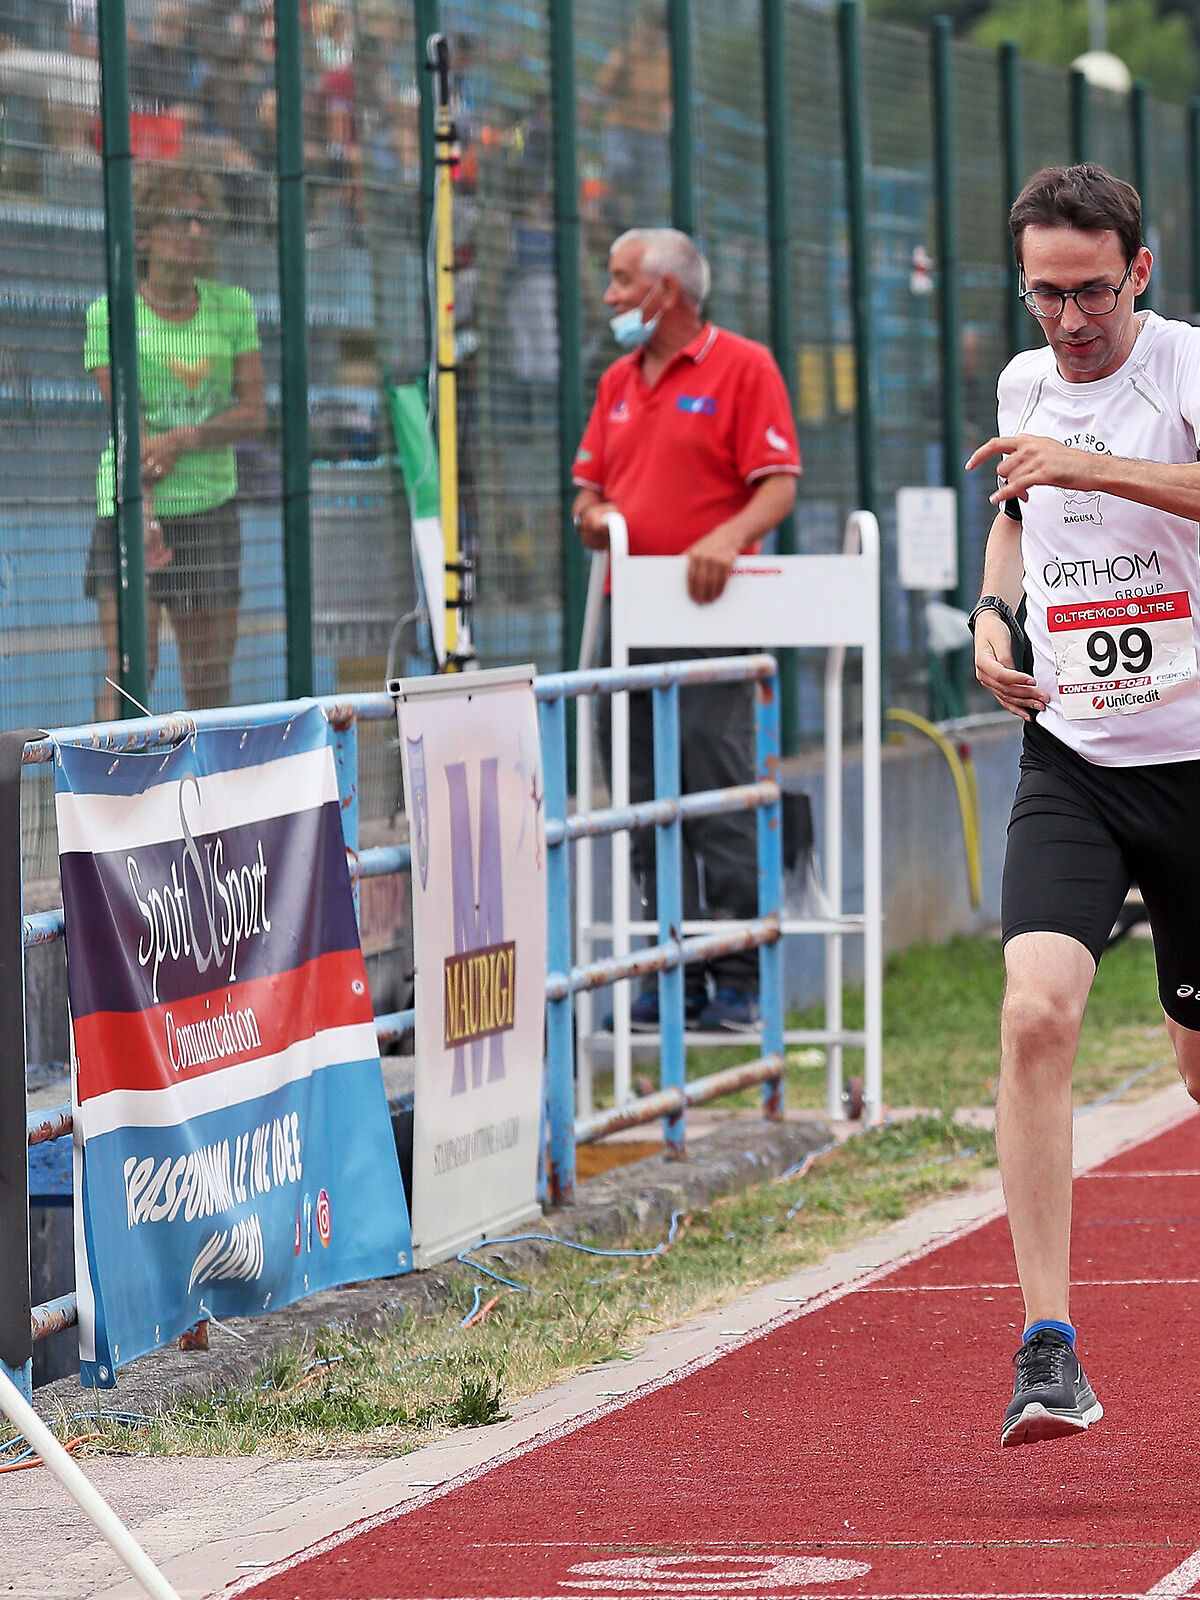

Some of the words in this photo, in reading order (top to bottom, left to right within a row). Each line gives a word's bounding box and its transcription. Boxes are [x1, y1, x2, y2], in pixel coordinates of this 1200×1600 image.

[1063, 513, 1095, 524] RAGUSA
[1043, 550, 1161, 588] ORTHOM
[1114, 583, 1164, 600] GROUP
[1086, 626, 1153, 678] 99
[1061, 680, 1116, 694] CONCESIO
[1118, 676, 1150, 690] 2021
[1105, 689, 1161, 708] UniCredit
[126, 855, 191, 1004] Spot
[213, 837, 272, 983] Sport
[445, 948, 514, 1042] MAURIGI
[164, 992, 262, 1072] Comunication
[234, 1131, 250, 1204] LE
[271, 1111, 302, 1187] IDEE
